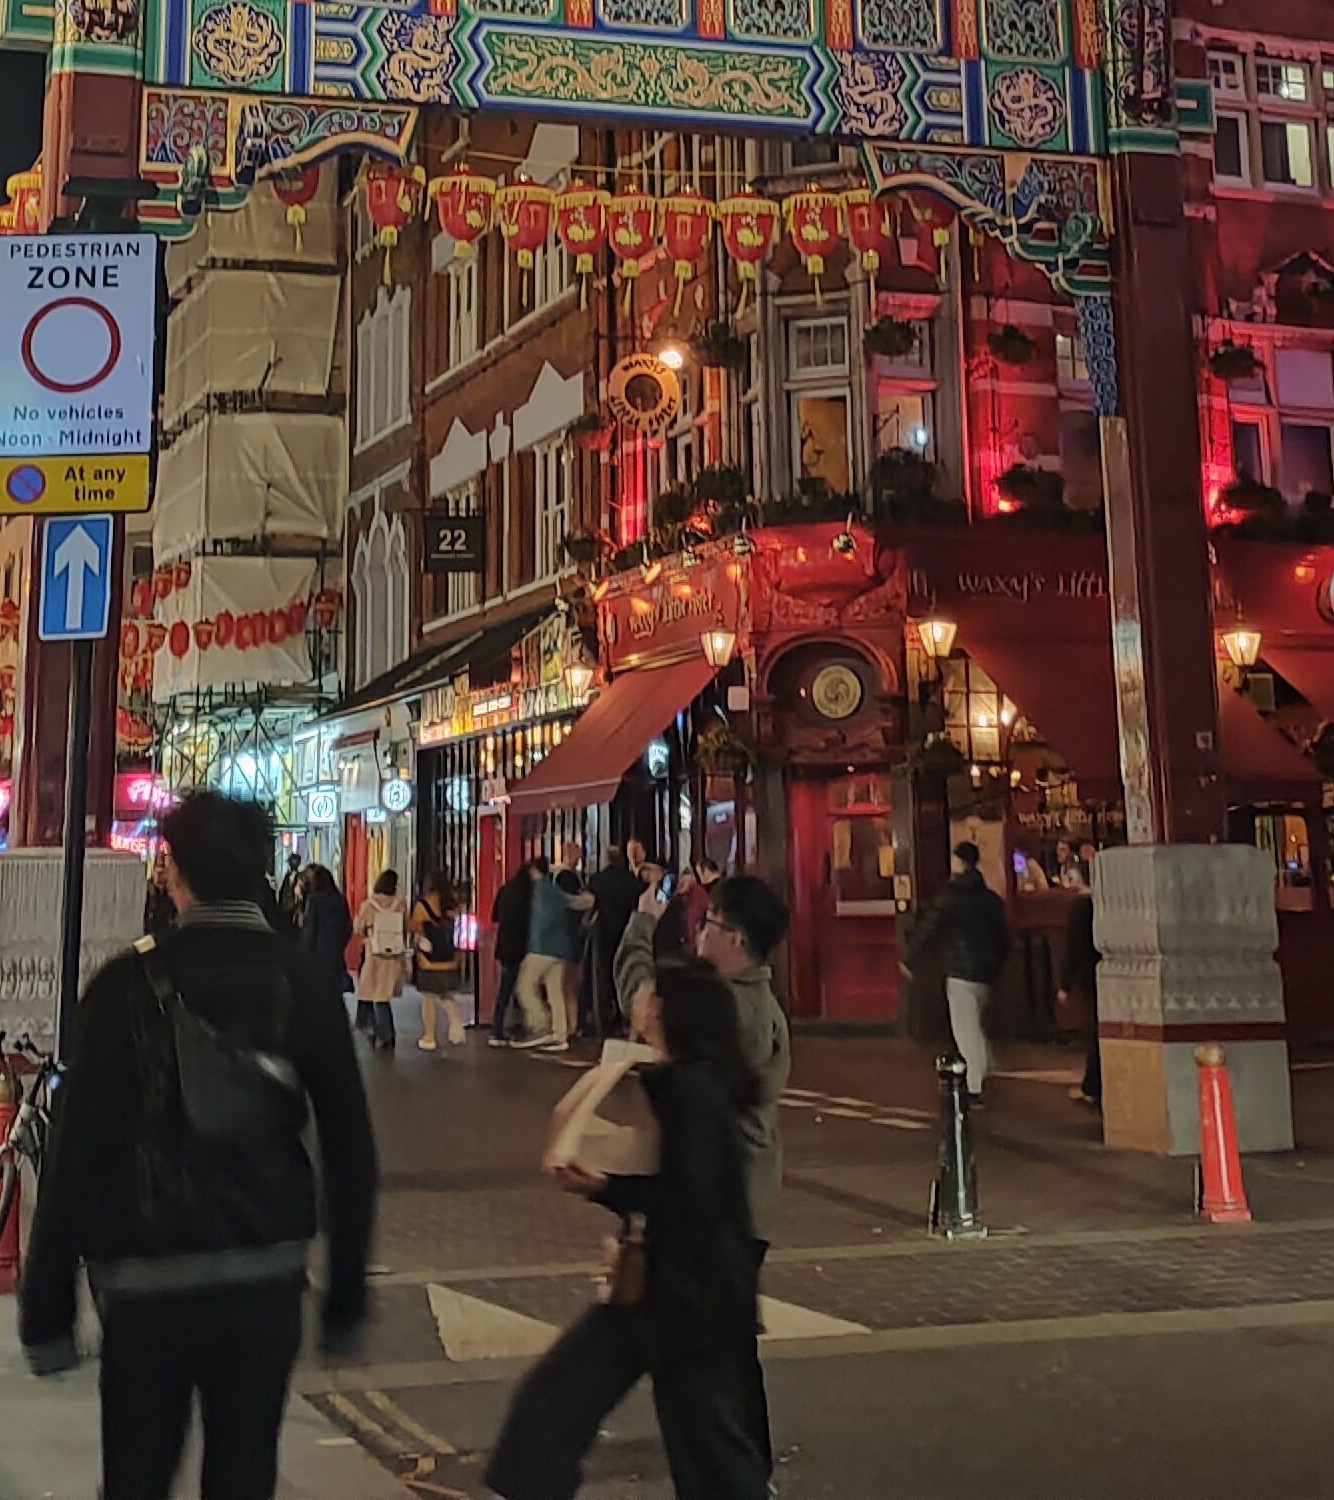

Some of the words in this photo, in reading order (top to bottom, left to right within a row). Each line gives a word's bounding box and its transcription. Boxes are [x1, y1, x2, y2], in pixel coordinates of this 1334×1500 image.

[10, 242, 141, 259] PEDESTRIAN
[27, 265, 120, 289] ZONE
[13, 405, 40, 421] No
[47, 404, 124, 421] vehicles
[59, 429, 143, 449] Midnight
[64, 465, 86, 482] At
[90, 468, 126, 484] any
[74, 485, 115, 502] time
[438, 529, 468, 551] 22
[1055, 567, 1107, 598] Littl
